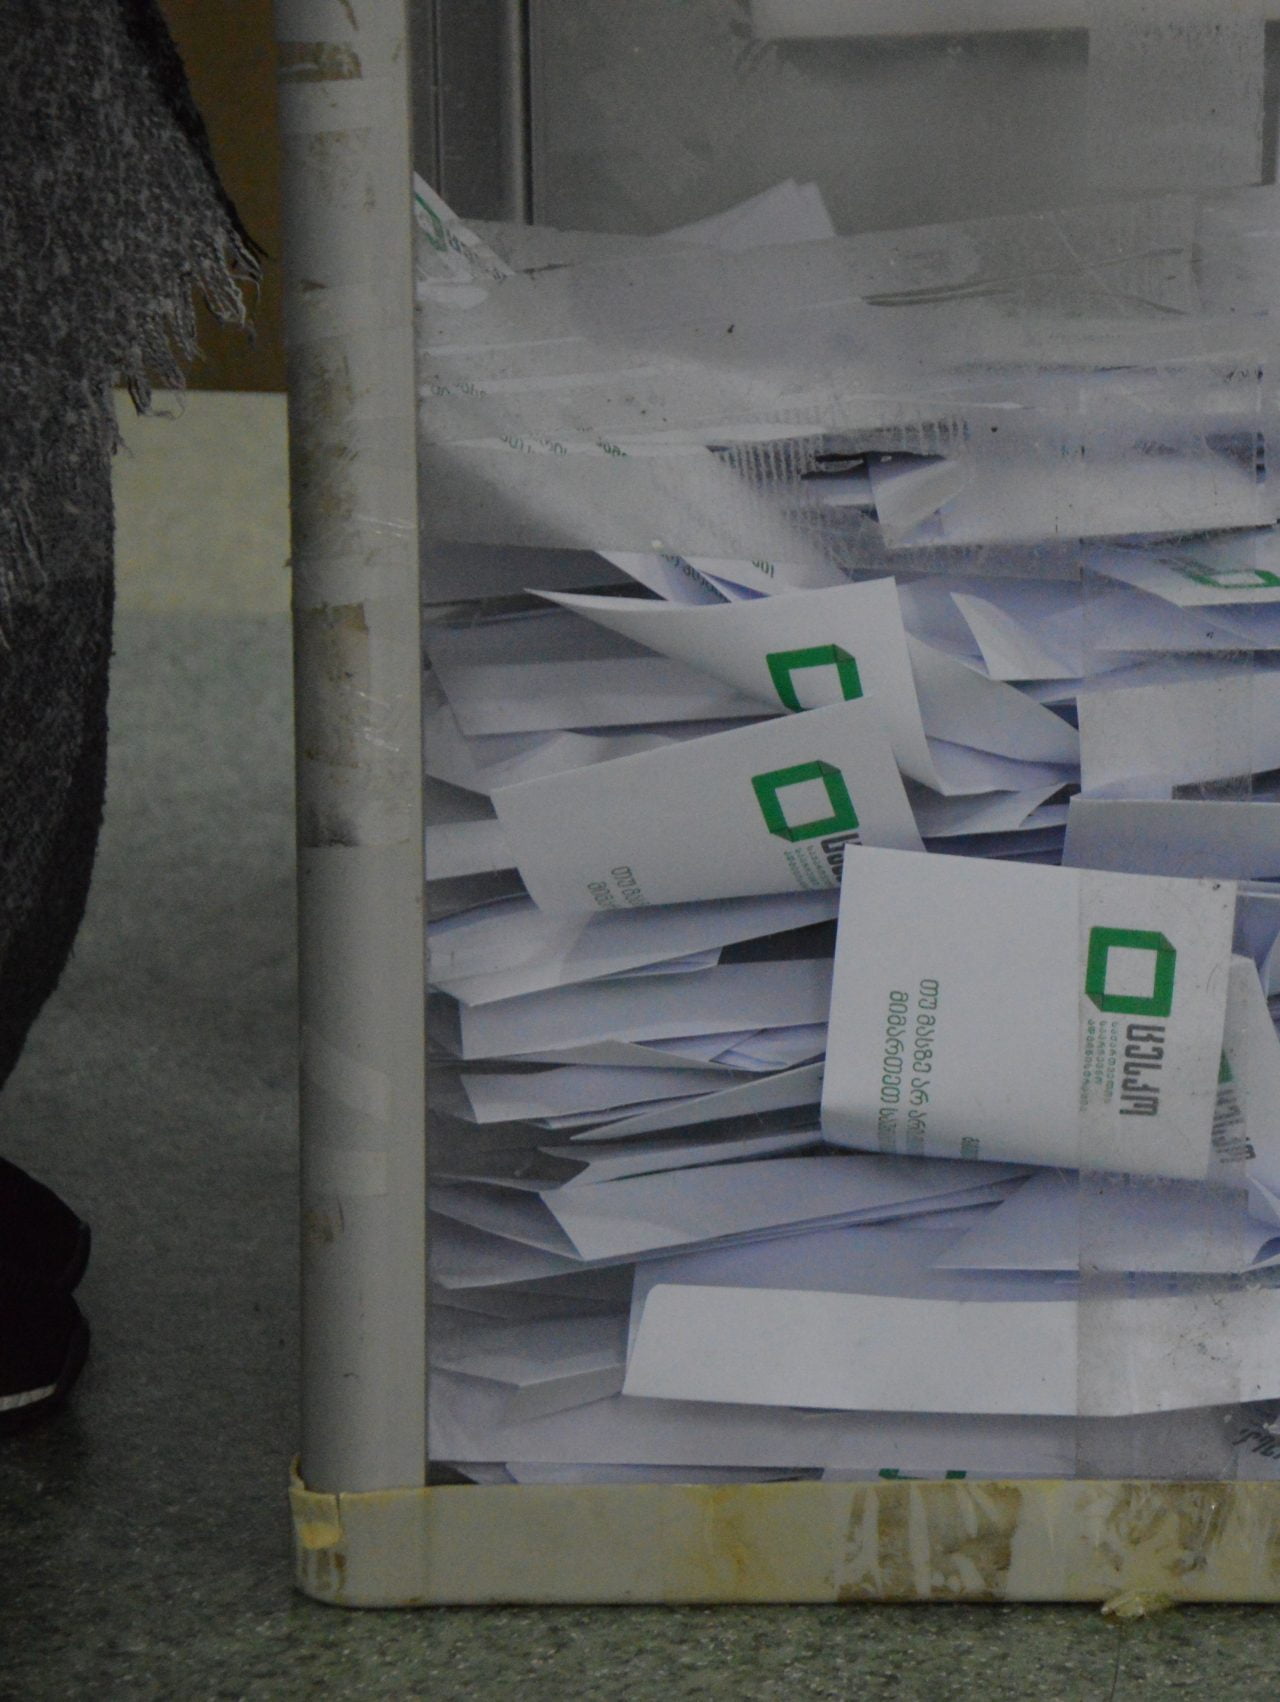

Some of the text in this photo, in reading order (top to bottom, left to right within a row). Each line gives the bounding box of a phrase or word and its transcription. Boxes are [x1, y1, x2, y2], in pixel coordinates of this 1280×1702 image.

[918, 979, 939, 1010] თუ
[881, 990, 909, 1105] მიმართეთ
[912, 1014, 936, 1074] მასზე
[1119, 1023, 1166, 1116] ცესკო
[910, 1077, 930, 1106] არ
